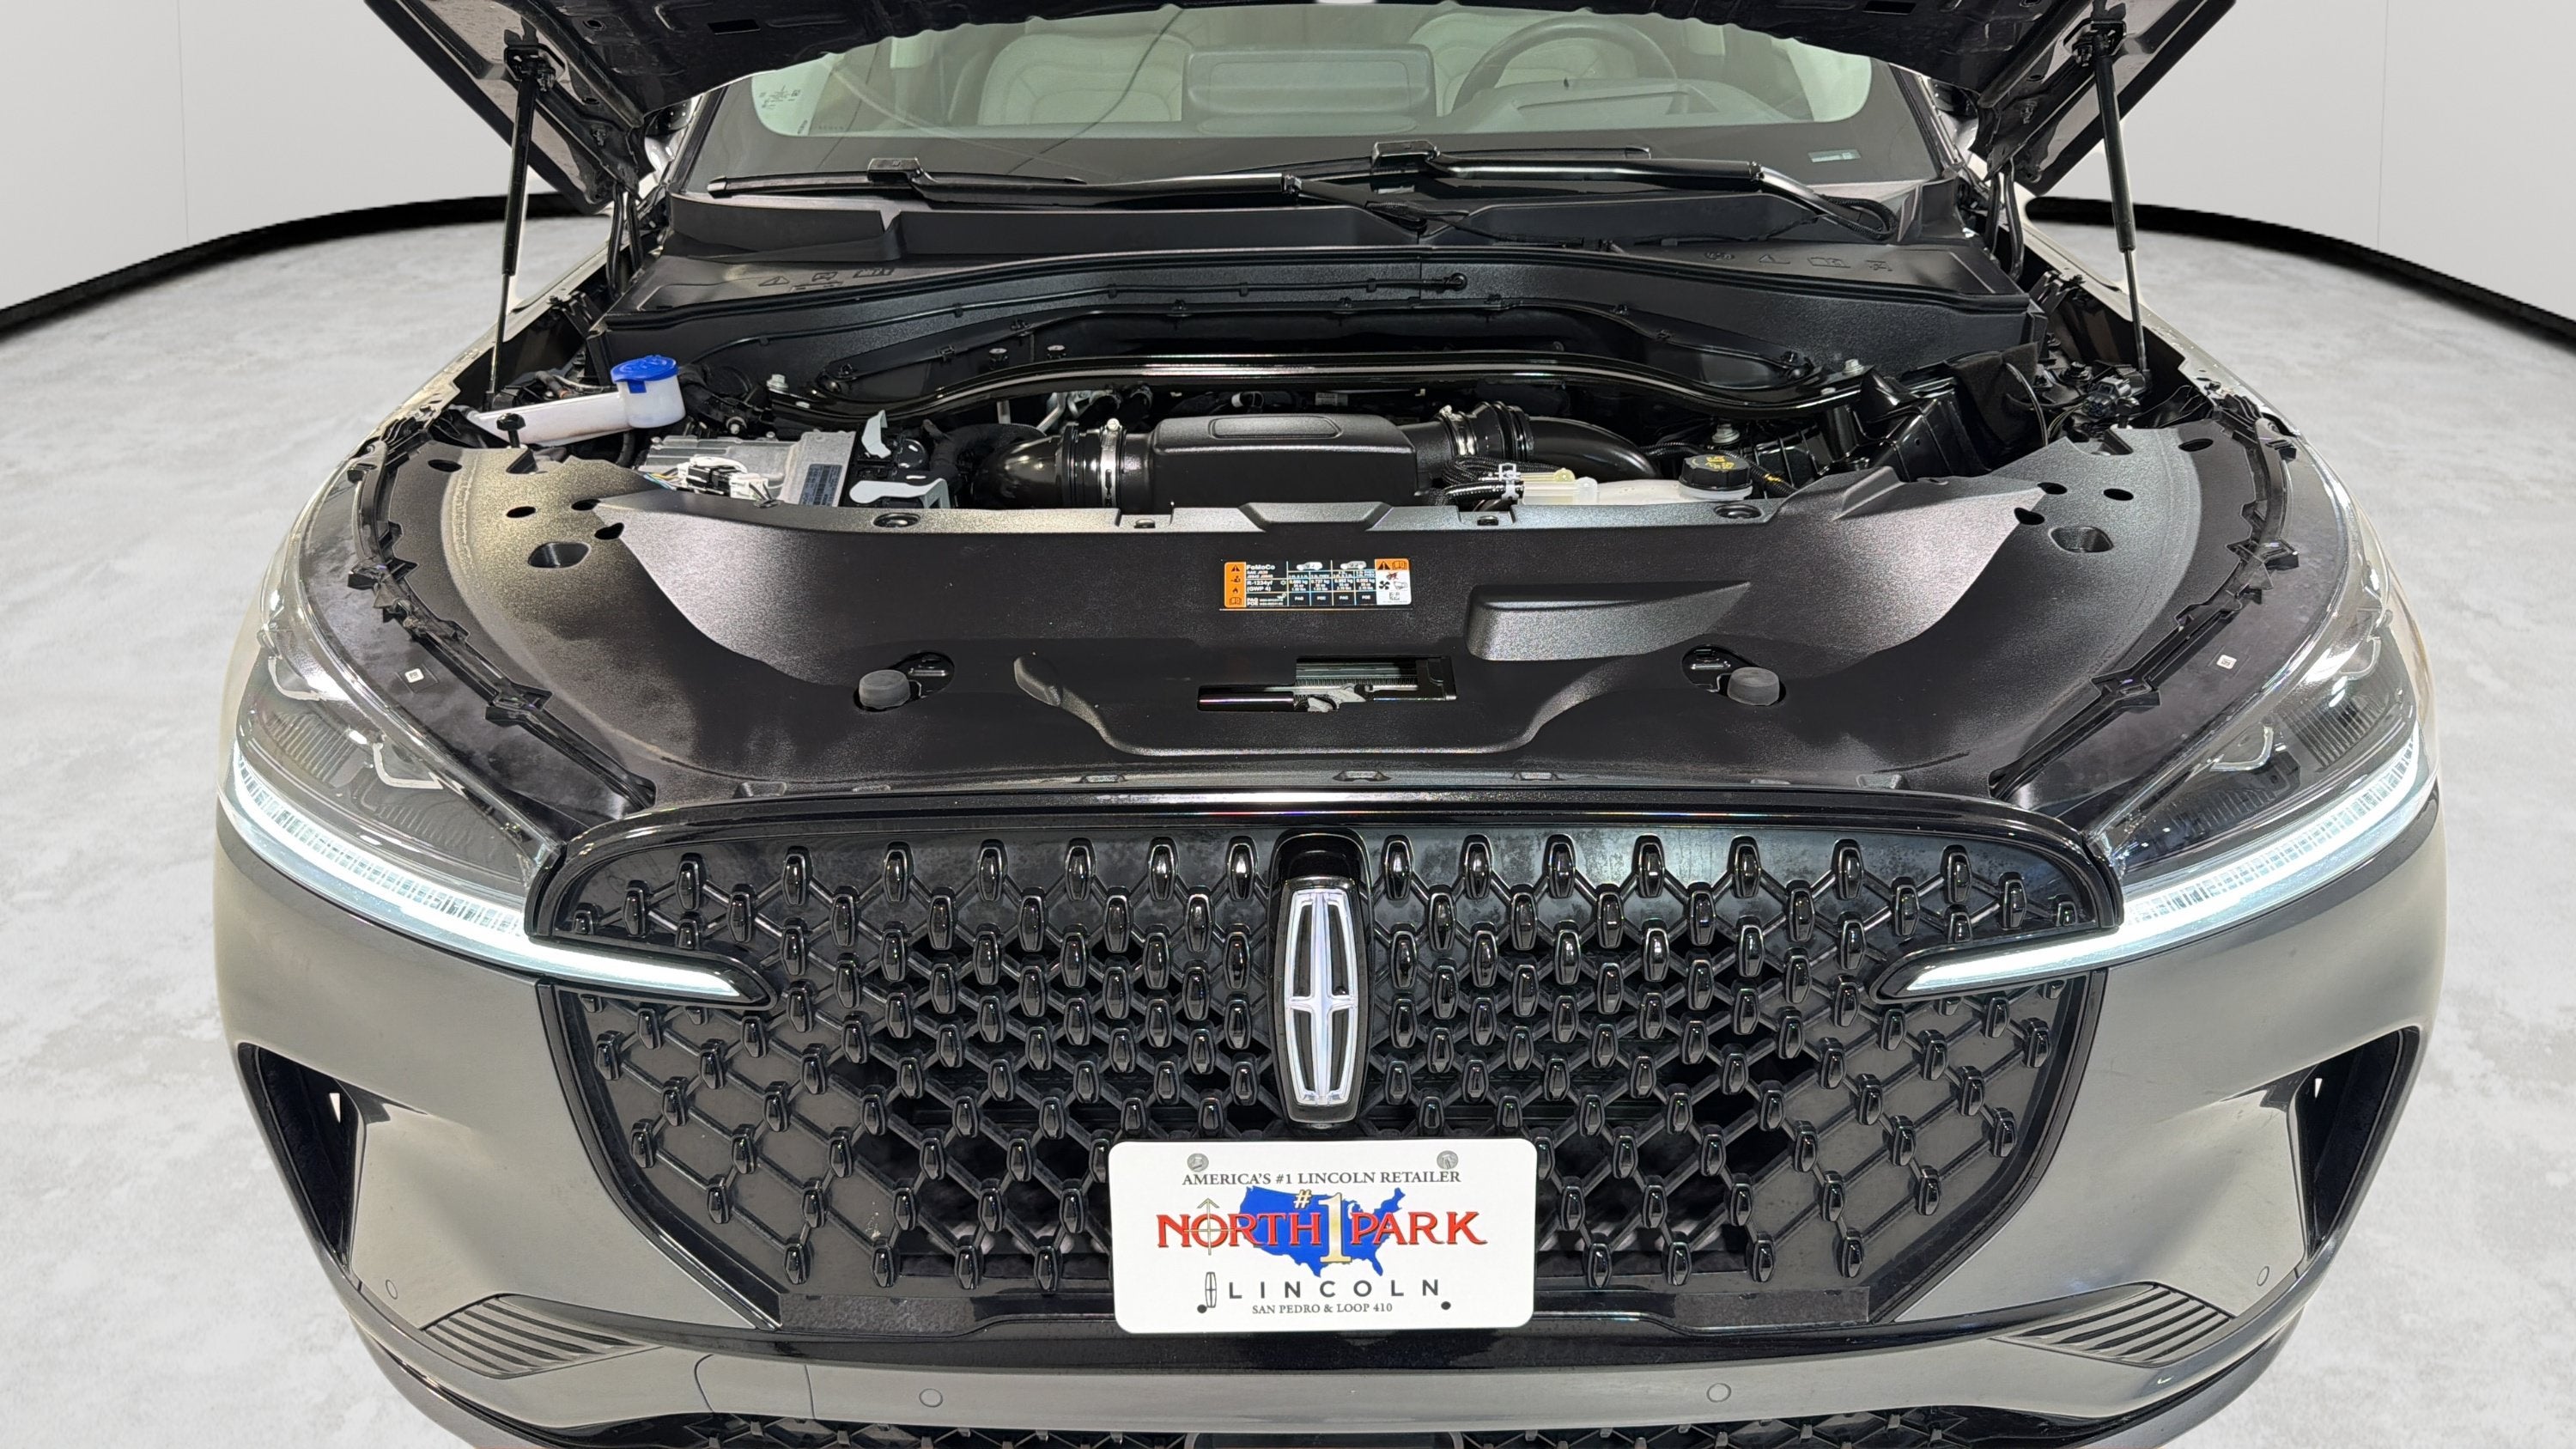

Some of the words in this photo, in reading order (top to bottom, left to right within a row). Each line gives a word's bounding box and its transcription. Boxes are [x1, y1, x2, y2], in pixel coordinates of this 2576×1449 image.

[1182, 1172, 1271, 1185] AMERICA'S
[1275, 1173, 1291, 1184] #1
[1297, 1172, 1376, 1184] LINCOLN
[1380, 1171, 1461, 1184] RETAILER
[1157, 1212, 1322, 1248] NORTH
[1350, 1211, 1488, 1245] PARK
[1229, 1279, 1439, 1299] LINCOLN
[1252, 1305, 1276, 1314] SAN
[1279, 1304, 1321, 1314] PEDRO
[1323, 1303, 1333, 1313] &
[1336, 1303, 1370, 1312] LOOP
[1373, 1302, 1393, 1312] 410
